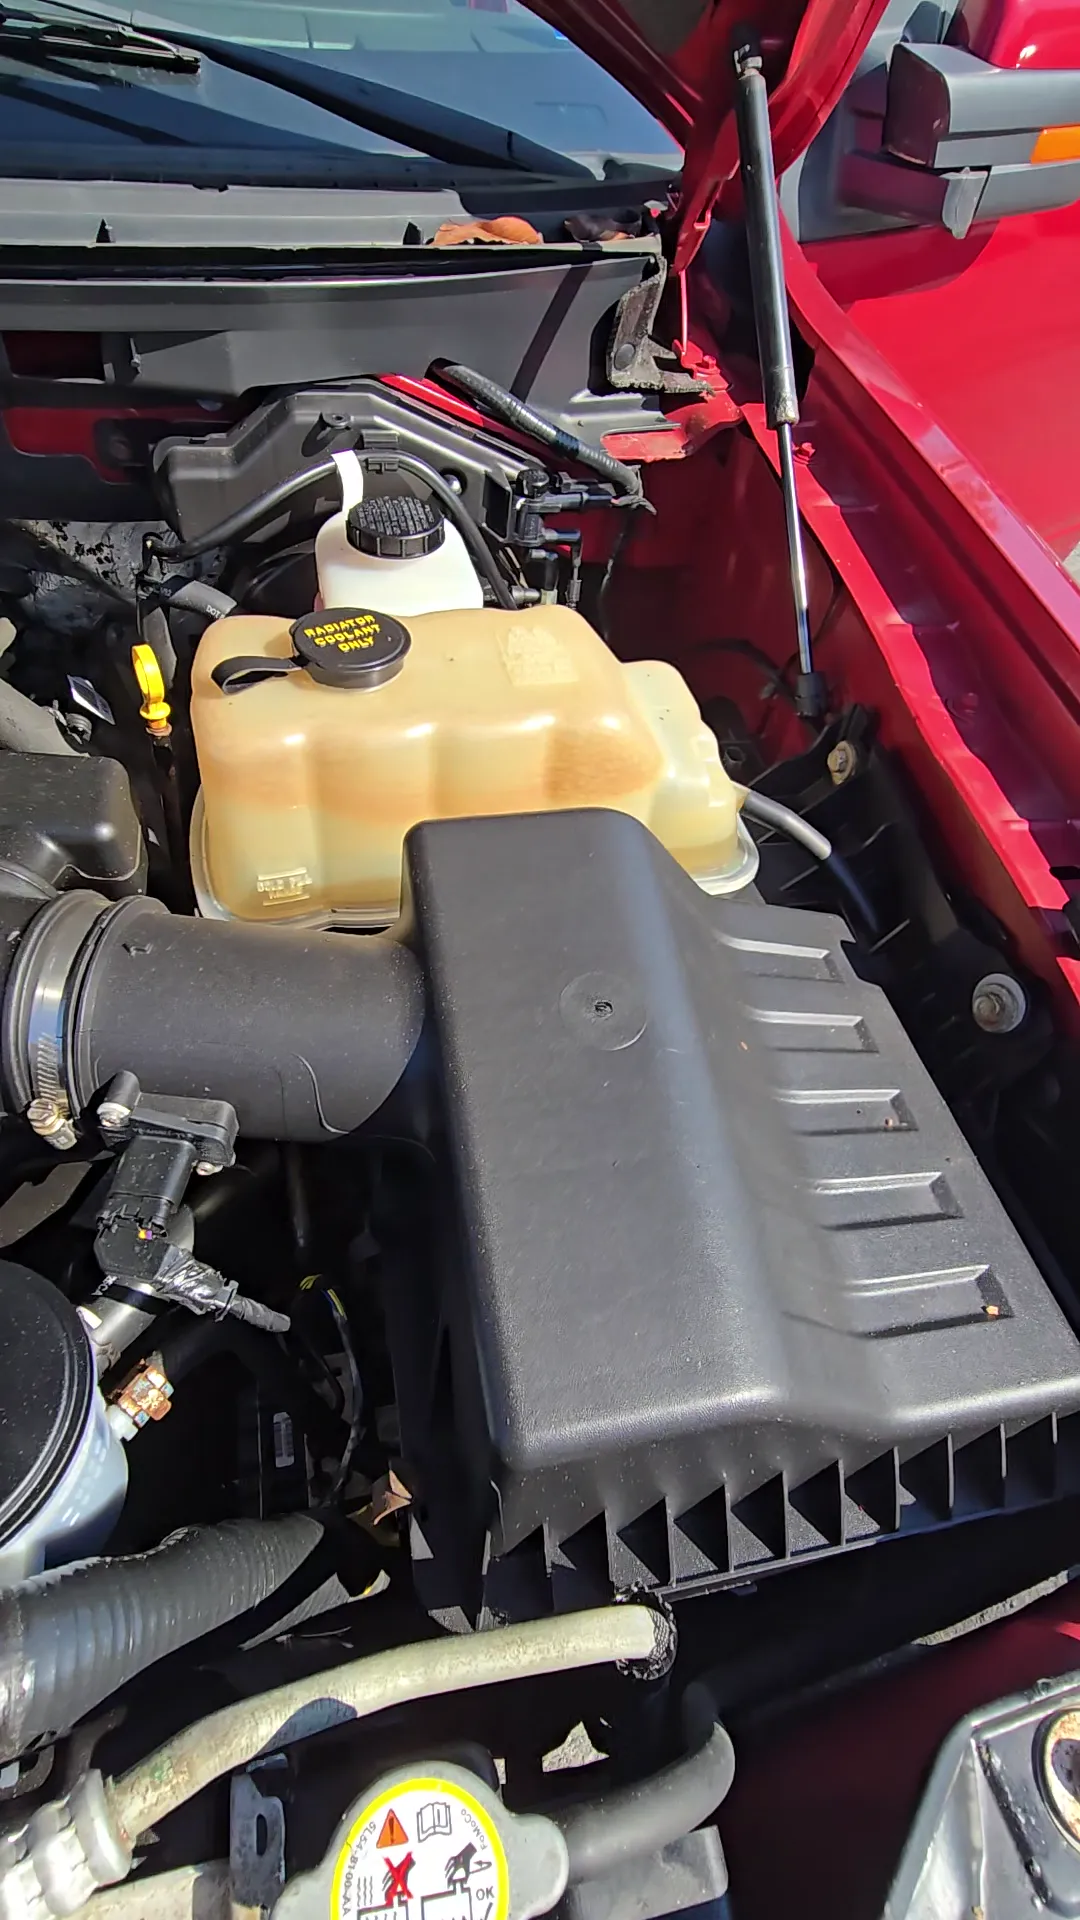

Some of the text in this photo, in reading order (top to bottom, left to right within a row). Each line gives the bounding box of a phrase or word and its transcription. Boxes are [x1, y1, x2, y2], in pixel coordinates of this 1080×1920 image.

[206, 604, 220, 619] DOT
[303, 614, 376, 639] RADIATOR
[314, 623, 380, 648] COOLANT
[337, 636, 374, 653] ONLY
[461, 1808, 488, 1850] FoMoCo
[475, 1886, 495, 1901] OK
